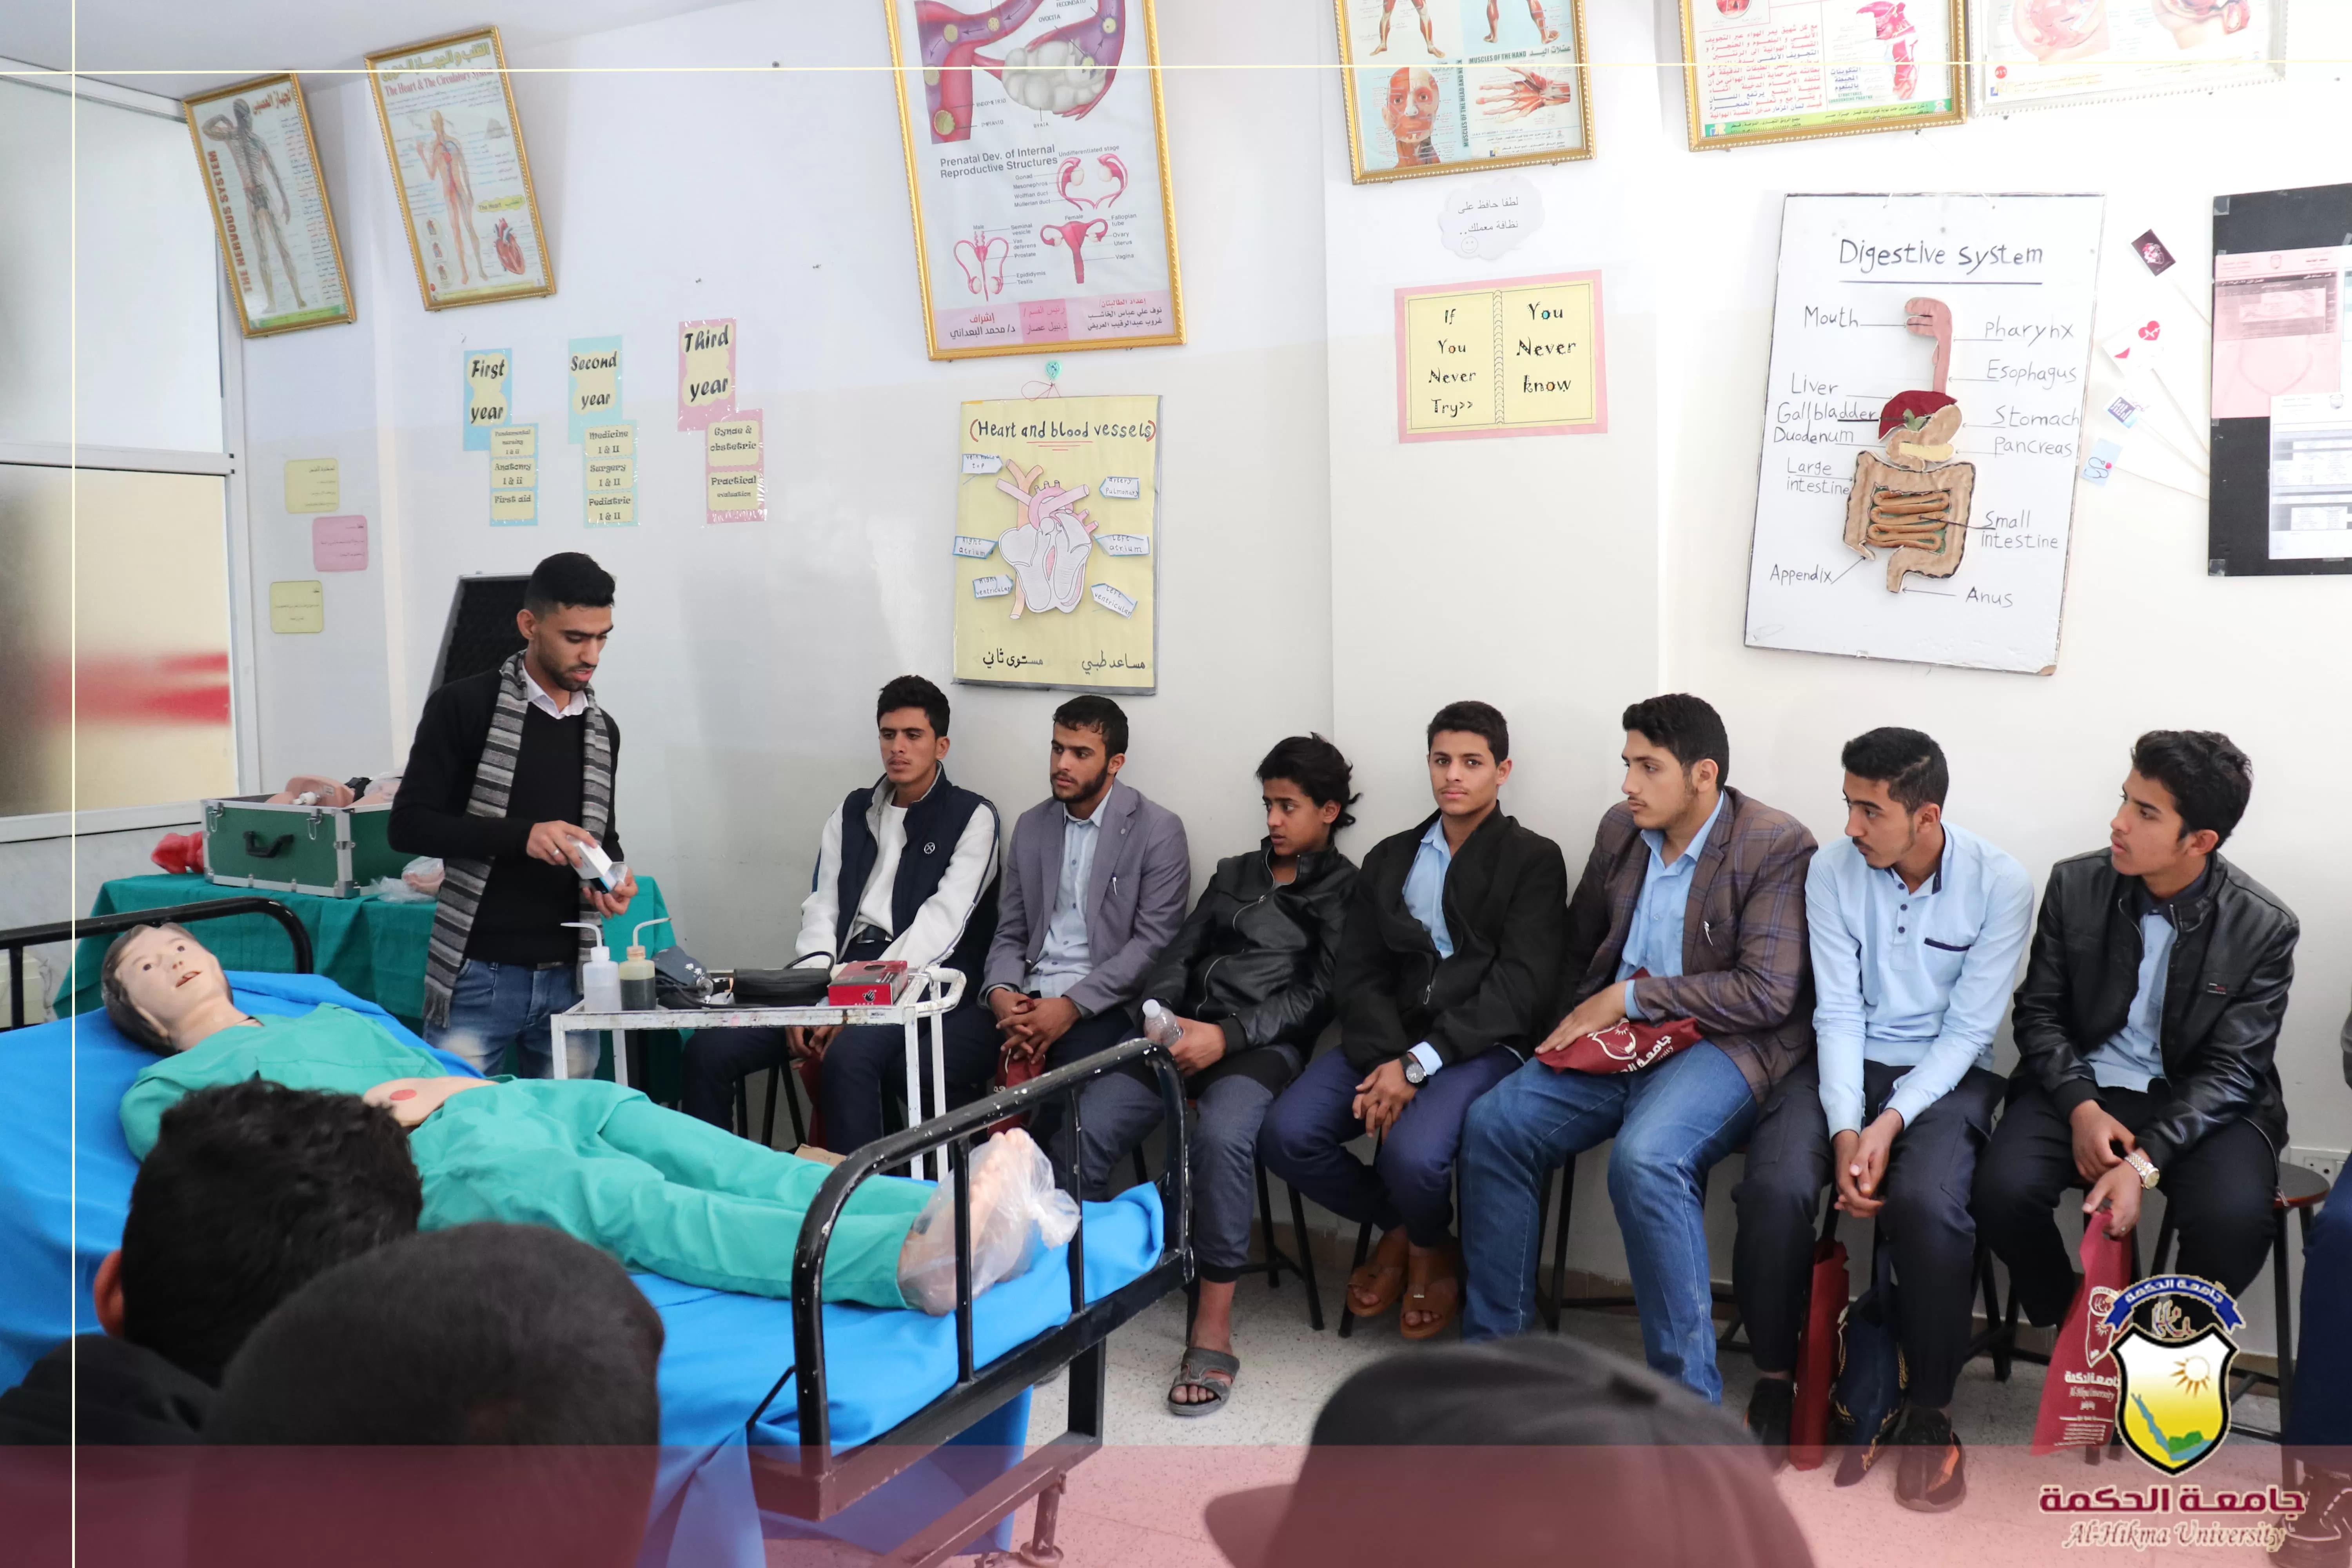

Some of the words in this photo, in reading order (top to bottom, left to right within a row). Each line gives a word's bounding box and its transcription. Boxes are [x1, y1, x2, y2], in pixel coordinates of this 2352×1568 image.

[1469, 55, 1493, 64] MUSCLES
[385, 85, 397, 96] The
[397, 82, 416, 94] Heart
[417, 79, 423, 89] &
[424, 77, 436, 88] The
[940, 154, 980, 167] Prenatal
[982, 152, 1002, 162] Dev.
[1005, 149, 1015, 159] of
[1018, 144, 1055, 157] Internal
[1058, 146, 1103, 157] Undifferentiated
[208, 151, 229, 203] SYSTEM
[940, 163, 1004, 179] Reproductive
[1006, 157, 1058, 170] Structures
[1013, 181, 1048, 189] Mesonephros
[1458, 201, 1474, 214] على
[1477, 200, 1499, 209] حافظ
[1502, 196, 1519, 206] لطفا
[1496, 219, 1518, 229] نظافة
[223, 206, 245, 266] NERVOUS
[1839, 239, 1945, 274] Digestive
[239, 270, 253, 294] THE
[970, 312, 995, 324] إشراف
[1137, 308, 1148, 317] علي
[1444, 309, 1457, 325] If
[1526, 301, 1564, 321] You
[1804, 305, 1859, 329] Mouth
[684, 324, 729, 353] Third
[950, 327, 983, 339] البعداني
[985, 327, 1005, 335] محمد
[1436, 339, 1466, 355] You
[1516, 336, 1577, 356] Never
[471, 359, 505, 379] First
[571, 350, 617, 371] Second
[1428, 367, 1477, 384] Never
[1987, 359, 2076, 390] Esophagus
[690, 377, 728, 403] year
[1523, 375, 1572, 394] know
[1791, 372, 1839, 396] Liver
[581, 393, 610, 410] year
[471, 406, 504, 424] year
[1778, 402, 1877, 425] Gallbladder
[1991, 405, 2080, 427] Stomach
[714, 426, 743, 436] Gynae
[745, 426, 752, 434] &
[1021, 421, 1045, 438] and
[1051, 421, 1089, 438] blood
[1774, 421, 1853, 444] Duodenum
[710, 441, 757, 452] obstetric
[494, 462, 531, 472] Anatomy
[590, 463, 626, 473] Surgery
[1787, 457, 1832, 475] Large
[599, 479, 603, 487] I
[605, 479, 611, 487] &
[613, 478, 621, 486] II
[711, 475, 757, 486] Practical
[1787, 476, 1850, 495] intestine
[494, 495, 516, 504] First
[518, 494, 531, 503] aid
[589, 497, 631, 506] Pediatric
[1985, 510, 2031, 529] Small
[962, 537, 981, 545] Right
[1109, 544, 1143, 553] atrium
[1981, 530, 2059, 550] intestine
[959, 547, 985, 557] atrium
[1770, 563, 1832, 585] Appendix
[976, 586, 1011, 595] ventricular
[1966, 587, 2013, 608] Anus
[1094, 592, 1132, 615] ventricular
[983, 648, 1004, 669] ثاني
[1006, 655, 1044, 668] مستوى
[1082, 650, 1107, 676] طبي
[1109, 653, 1146, 669] مساعد
[1636, 1035, 1672, 1068] جامعة
